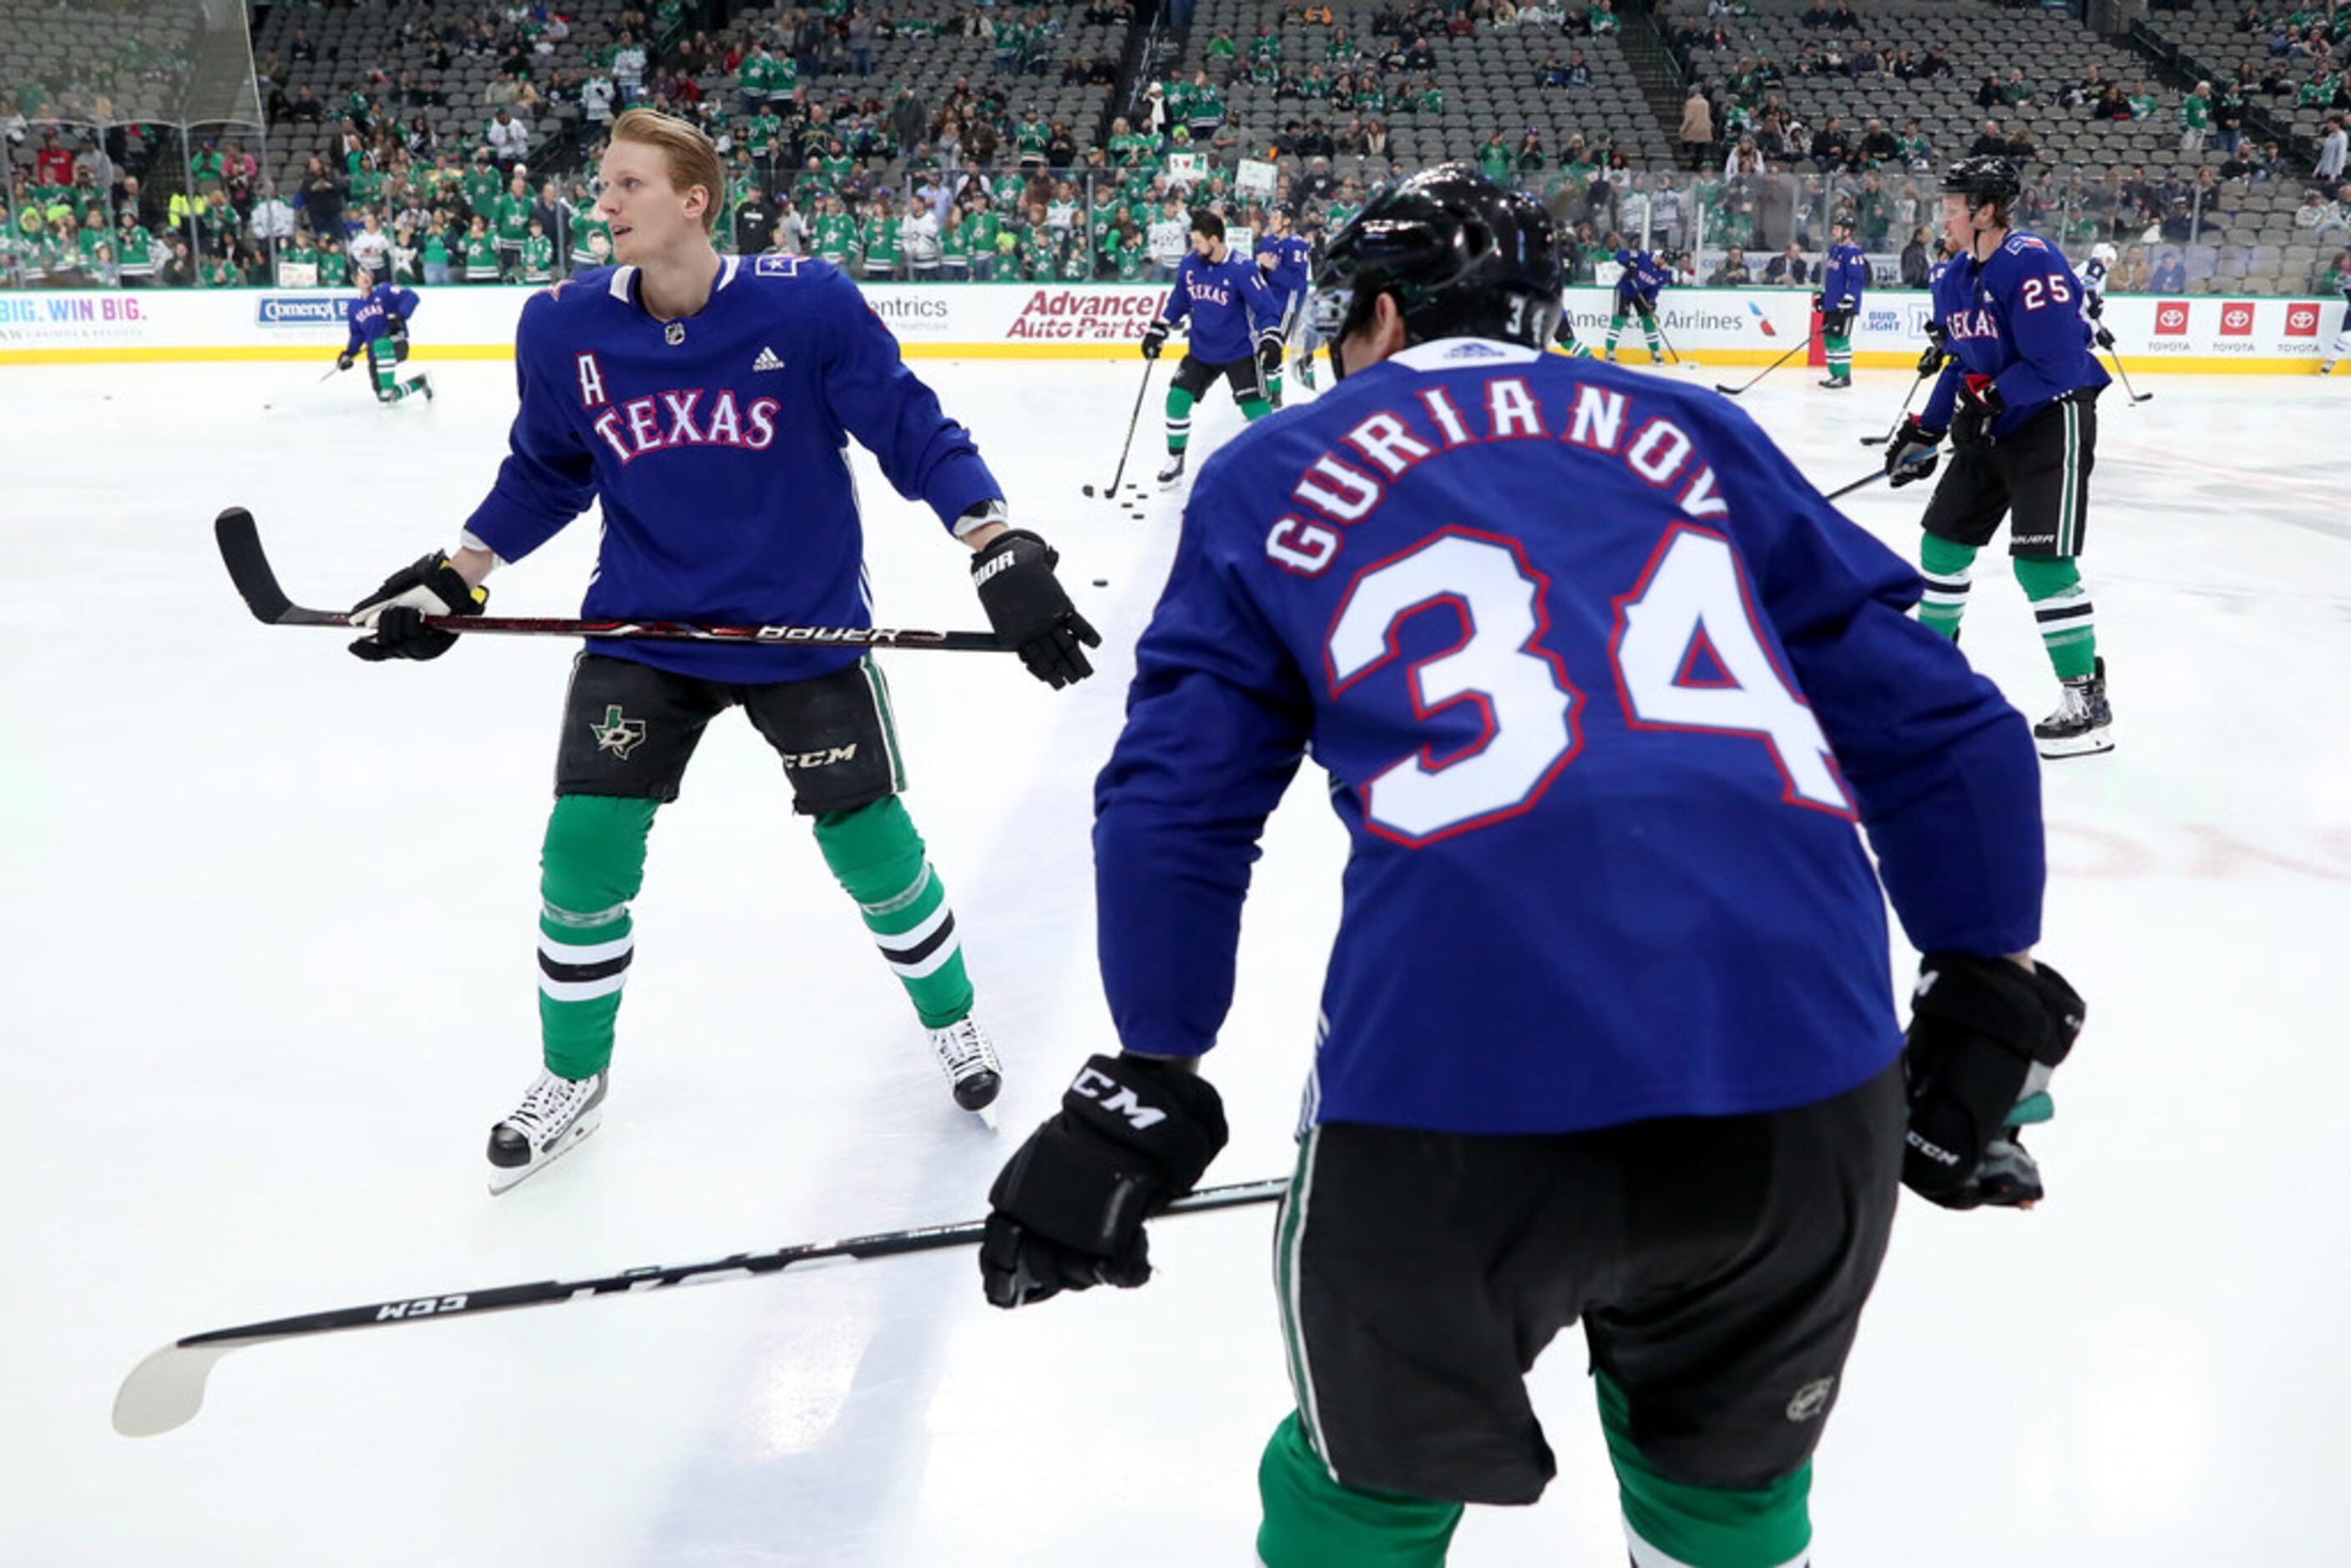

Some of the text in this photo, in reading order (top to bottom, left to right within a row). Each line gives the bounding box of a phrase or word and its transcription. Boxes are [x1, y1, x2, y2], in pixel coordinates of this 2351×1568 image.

[1186, 270, 1195, 285] C
[1021, 290, 1155, 316] Advance
[1186, 284, 1230, 306] TEXAS
[2023, 274, 2070, 311] 25
[0, 297, 147, 322] BIG. WIN BIG.
[1664, 310, 1743, 331] Airlines
[1868, 311, 1897, 321] BUD
[1006, 316, 1150, 338] Auto Parts
[2148, 341, 2192, 352] TOYOTA
[2212, 342, 2255, 352] TOYOTA
[2277, 343, 2321, 353] TOYOTA
[575, 350, 612, 409] A
[593, 388, 781, 466] TEXAS
[1265, 376, 1730, 578] GURIANOV
[756, 625, 897, 643] BAUER
[1324, 521, 1860, 849] 34
[783, 742, 858, 770] CCM
[1907, 1129, 1961, 1167] CCM
[376, 1294, 468, 1321] CCM
